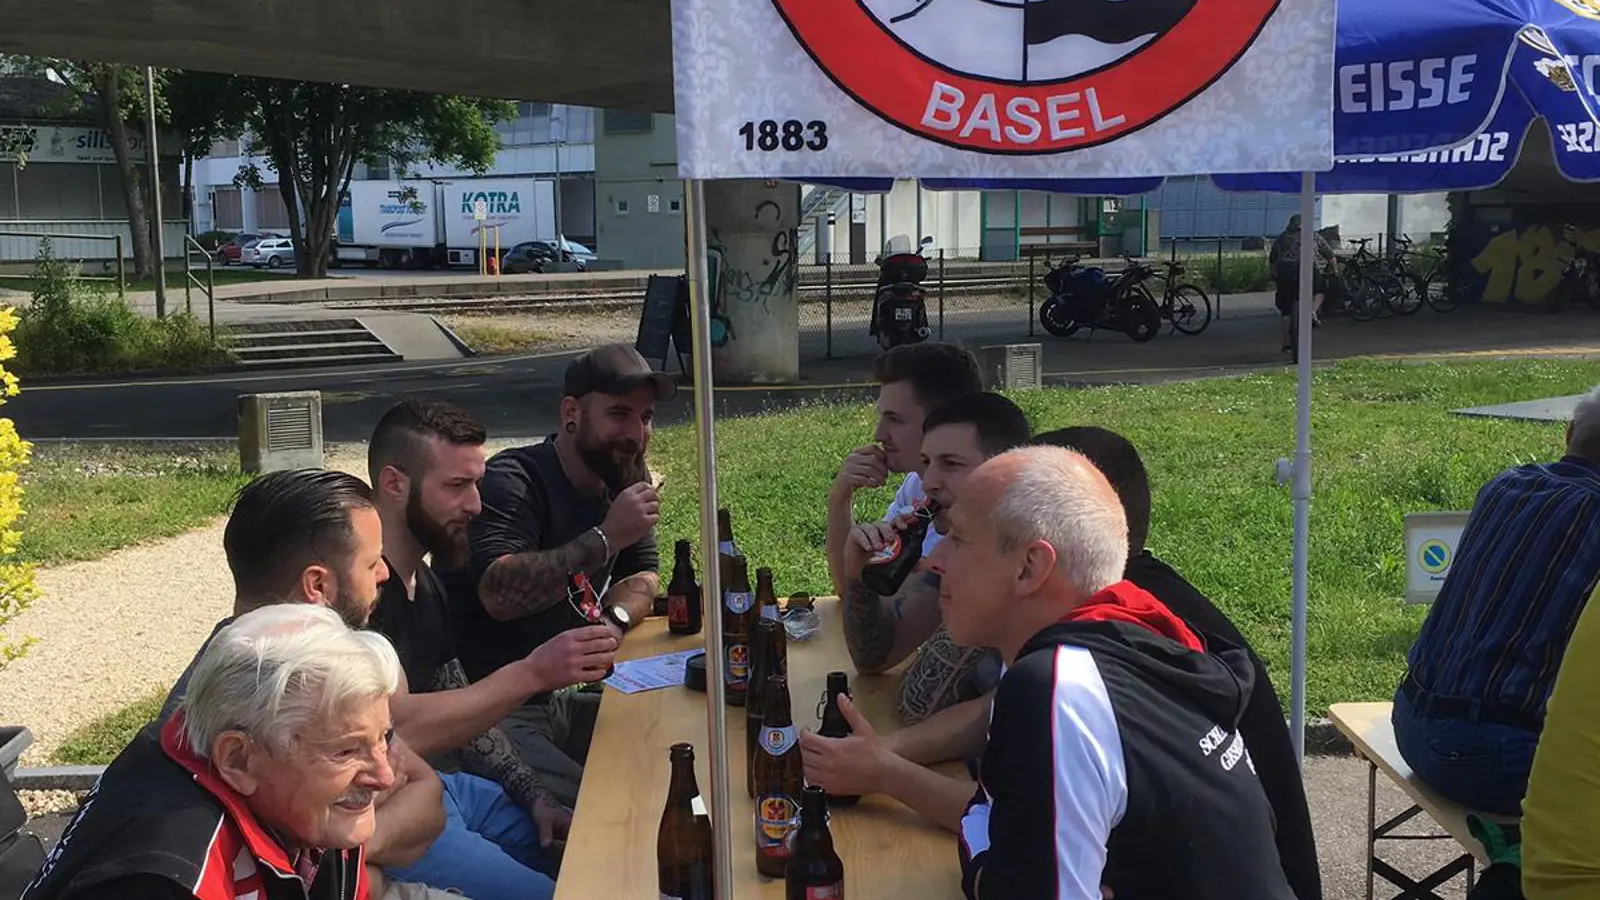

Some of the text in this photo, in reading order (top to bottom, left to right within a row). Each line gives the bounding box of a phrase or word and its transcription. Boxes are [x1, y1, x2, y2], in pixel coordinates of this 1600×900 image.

[1338, 54, 1477, 113] EISSE
[920, 81, 1126, 143] BASEL
[738, 119, 828, 152] 1883
[461, 191, 521, 214] KOTRA
